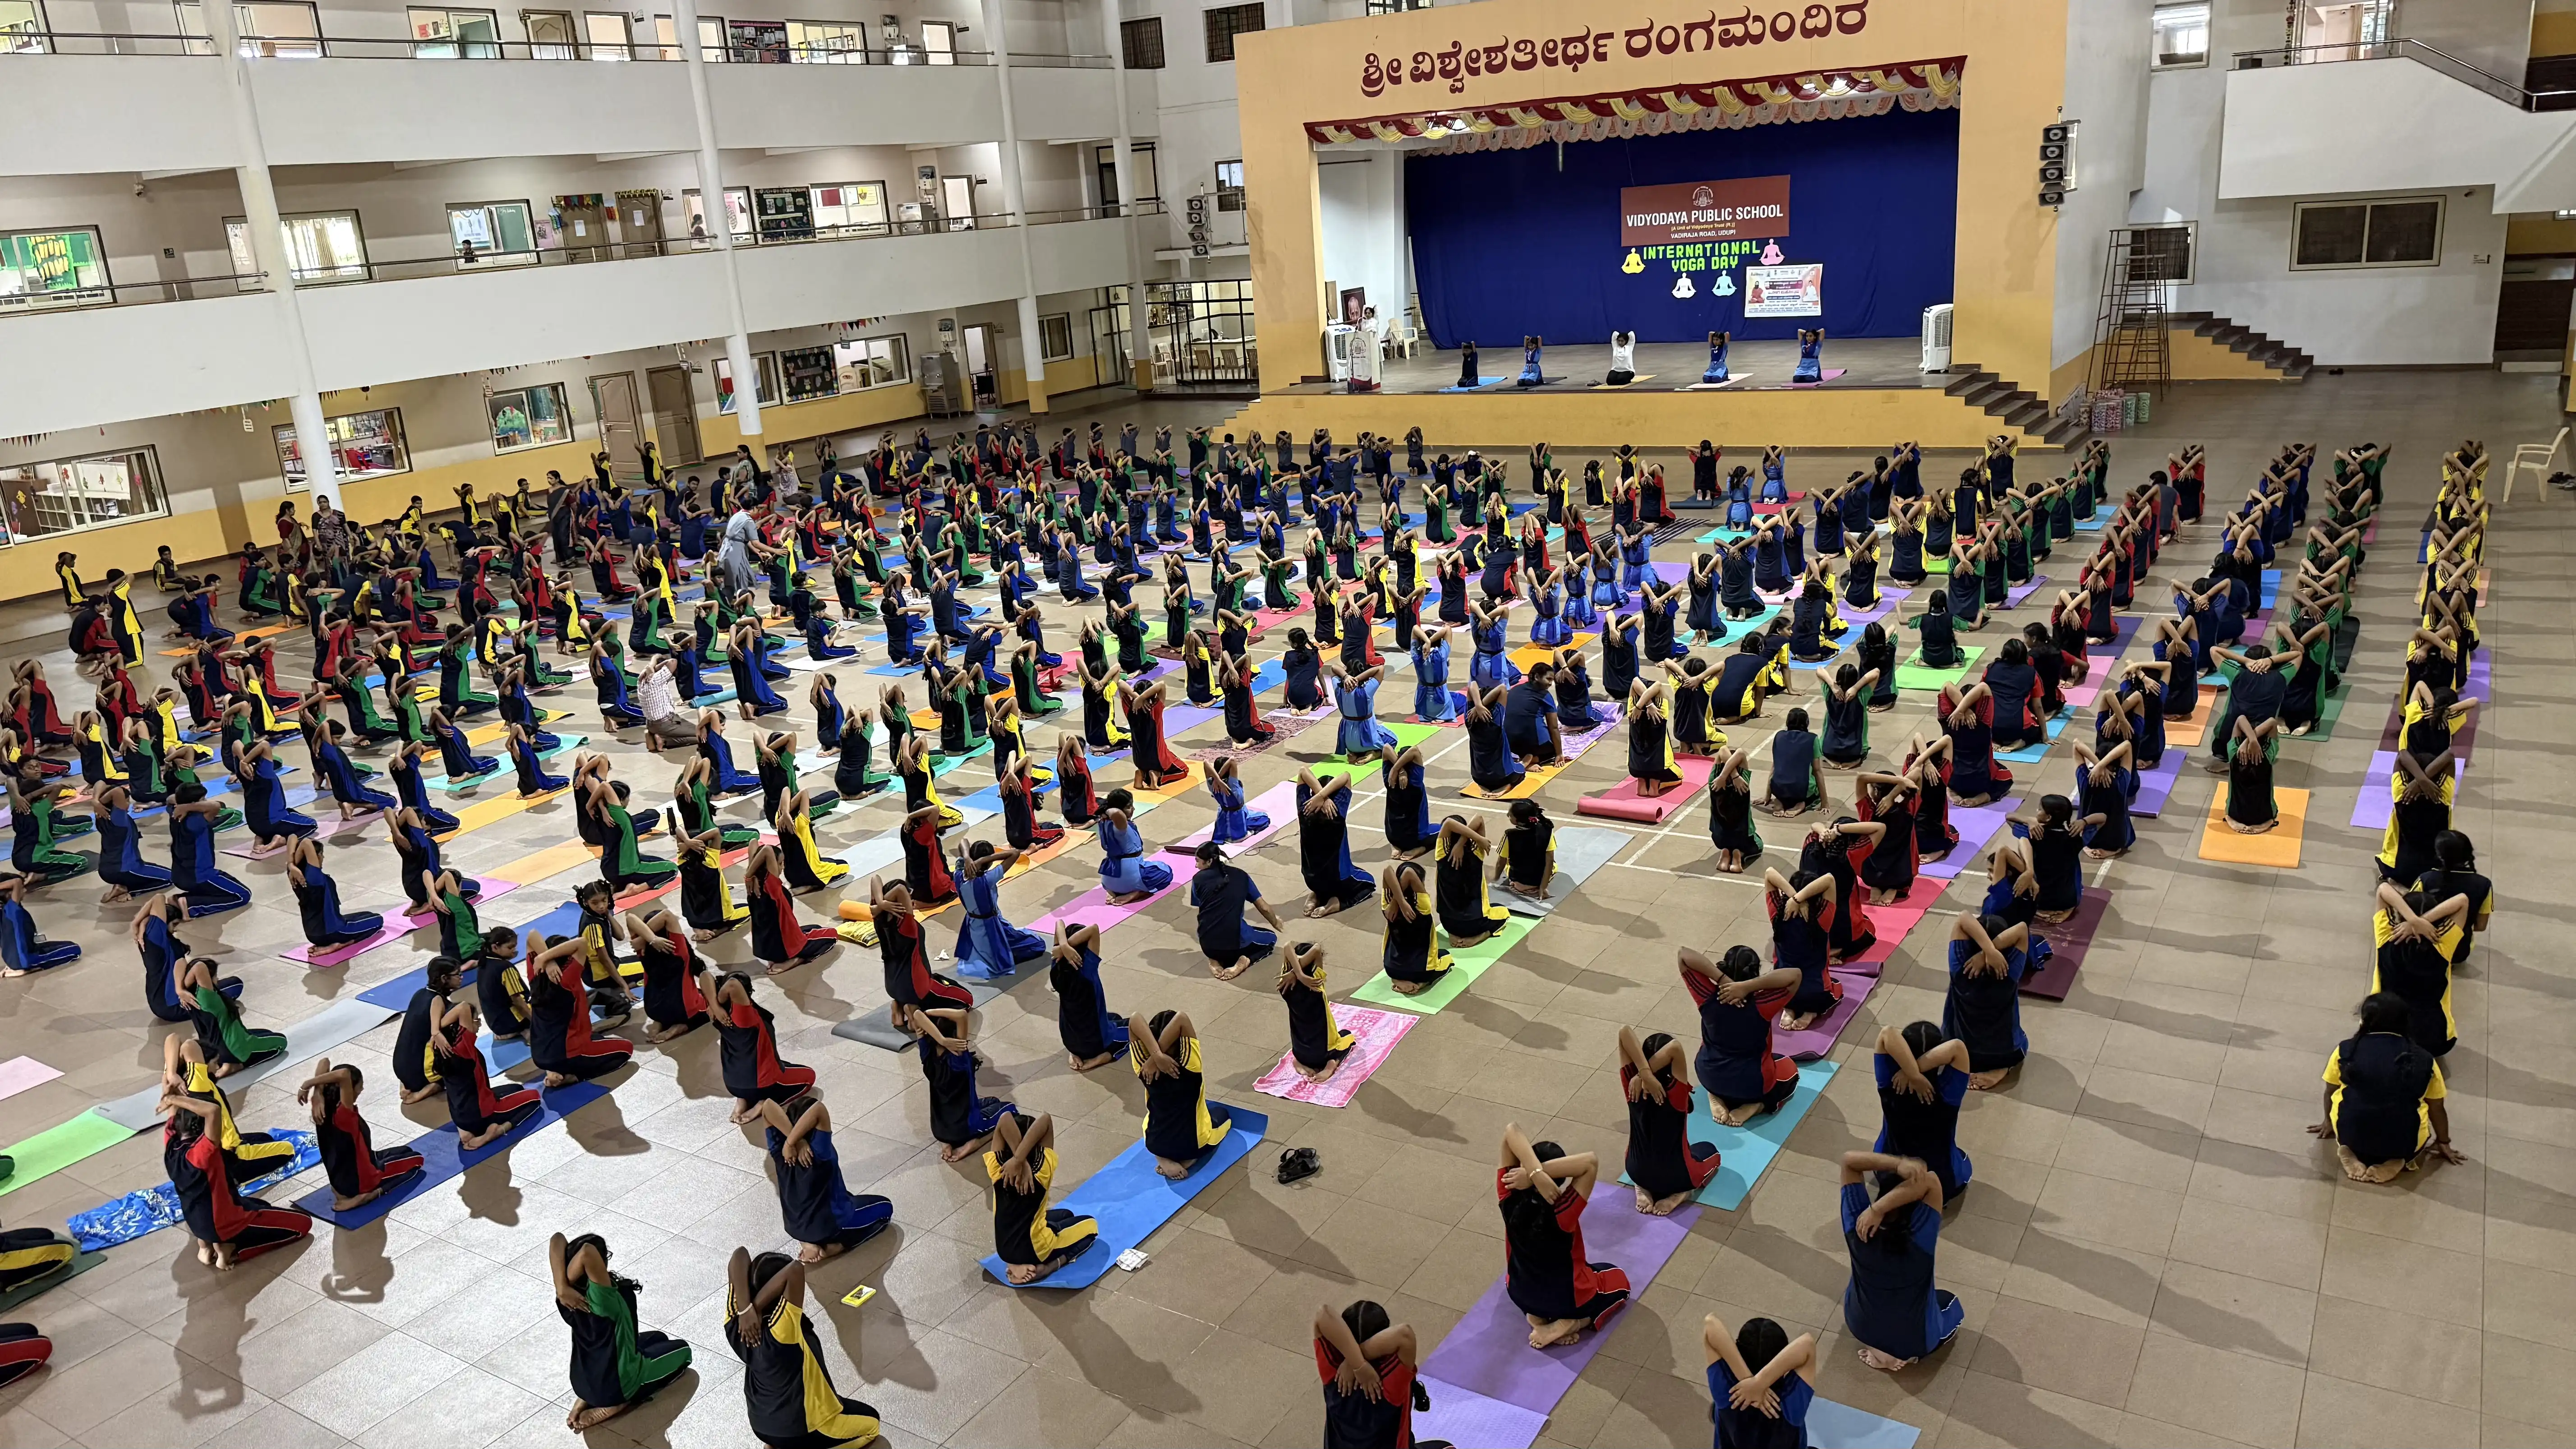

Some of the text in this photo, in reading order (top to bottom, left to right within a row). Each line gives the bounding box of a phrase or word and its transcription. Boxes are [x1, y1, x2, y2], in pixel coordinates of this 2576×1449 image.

[1361, 0, 1869, 97] ಶ್ರೀ ವಿಶ್ವೇಶತೀರ್ಥ ರಂಗಮಂದಿರ
[1626, 204, 1783, 227] VIDYODAYA PUBLIC SCHOOL
[1643, 241, 1761, 259] INTERNATIONAL
[1671, 256, 1738, 272] YOGA DAY
